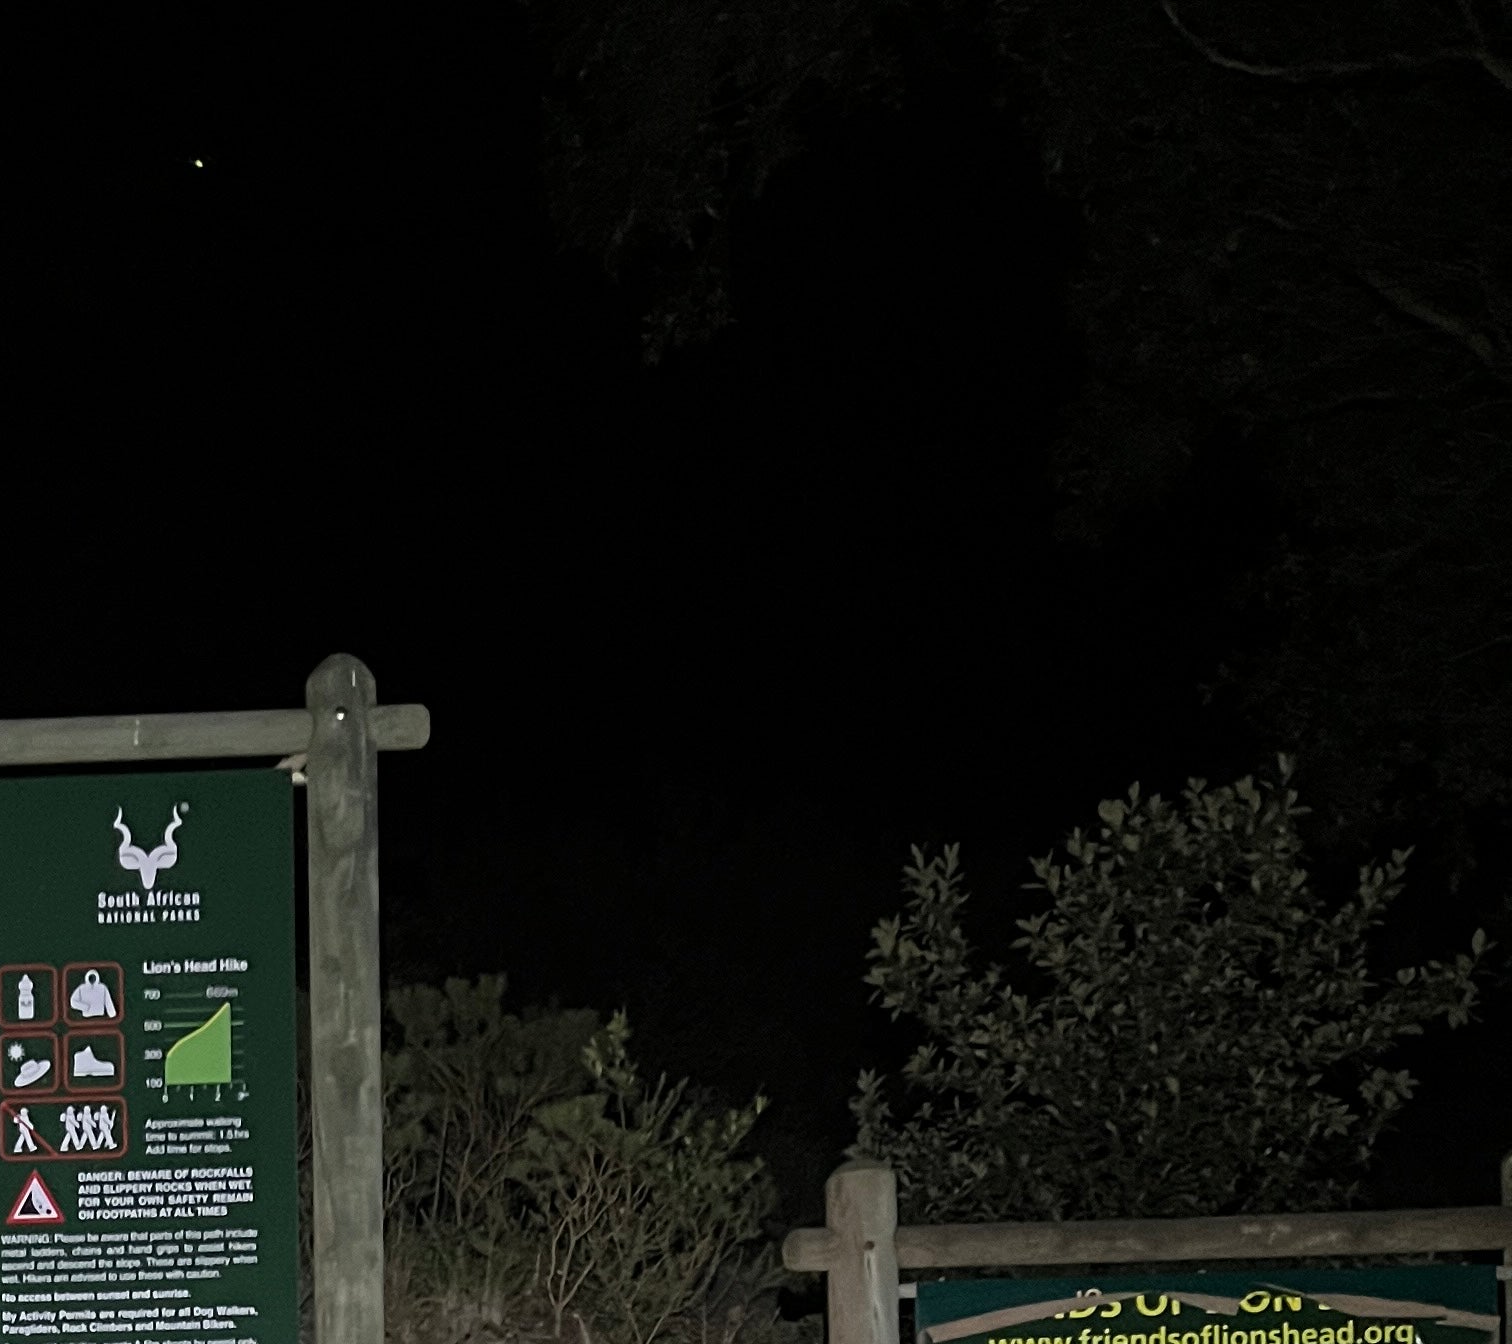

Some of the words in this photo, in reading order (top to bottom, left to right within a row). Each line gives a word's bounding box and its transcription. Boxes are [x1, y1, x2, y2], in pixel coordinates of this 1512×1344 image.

[98, 892, 139, 908] South
[147, 891, 199, 906] African
[143, 961, 181, 974] Lion's
[184, 960, 216, 972] Head
[220, 959, 247, 971] Hike
[128, 1170, 172, 1181] BEWARE
[174, 1169, 189, 1179] OF
[191, 1167, 253, 1178] ROCKFALLS
[79, 1210, 94, 1220] ON
[97, 1208, 157, 1219] FOOTPATHS
[159, 1207, 172, 1217] AT
[174, 1207, 194, 1217] ALL
[196, 1206, 227, 1216] TIMES
